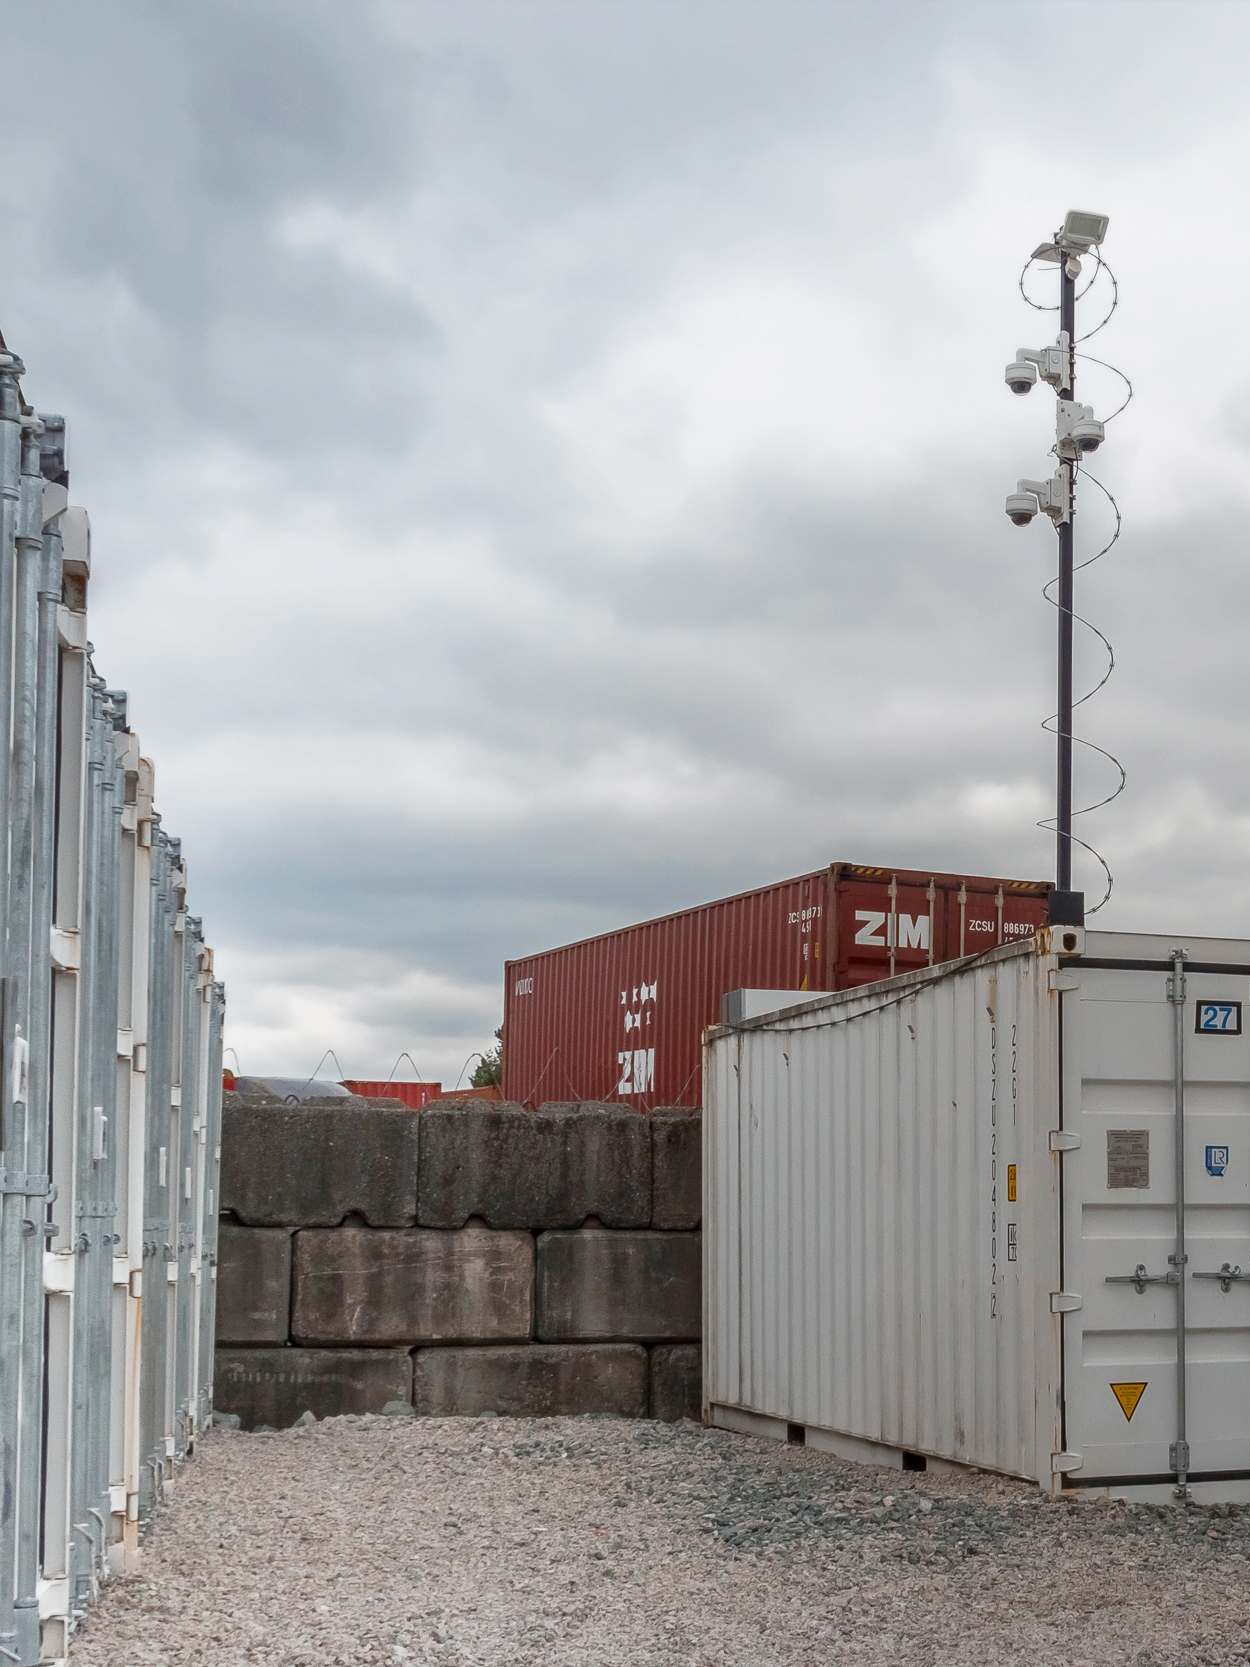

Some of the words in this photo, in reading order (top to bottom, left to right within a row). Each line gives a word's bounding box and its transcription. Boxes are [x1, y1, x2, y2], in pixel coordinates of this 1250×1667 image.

[855, 910, 930, 949] ZIM
[968, 919, 995, 932] ZCSU
[1203, 1006, 1233, 1029] 27
[1213, 1150, 1225, 1165] LR
